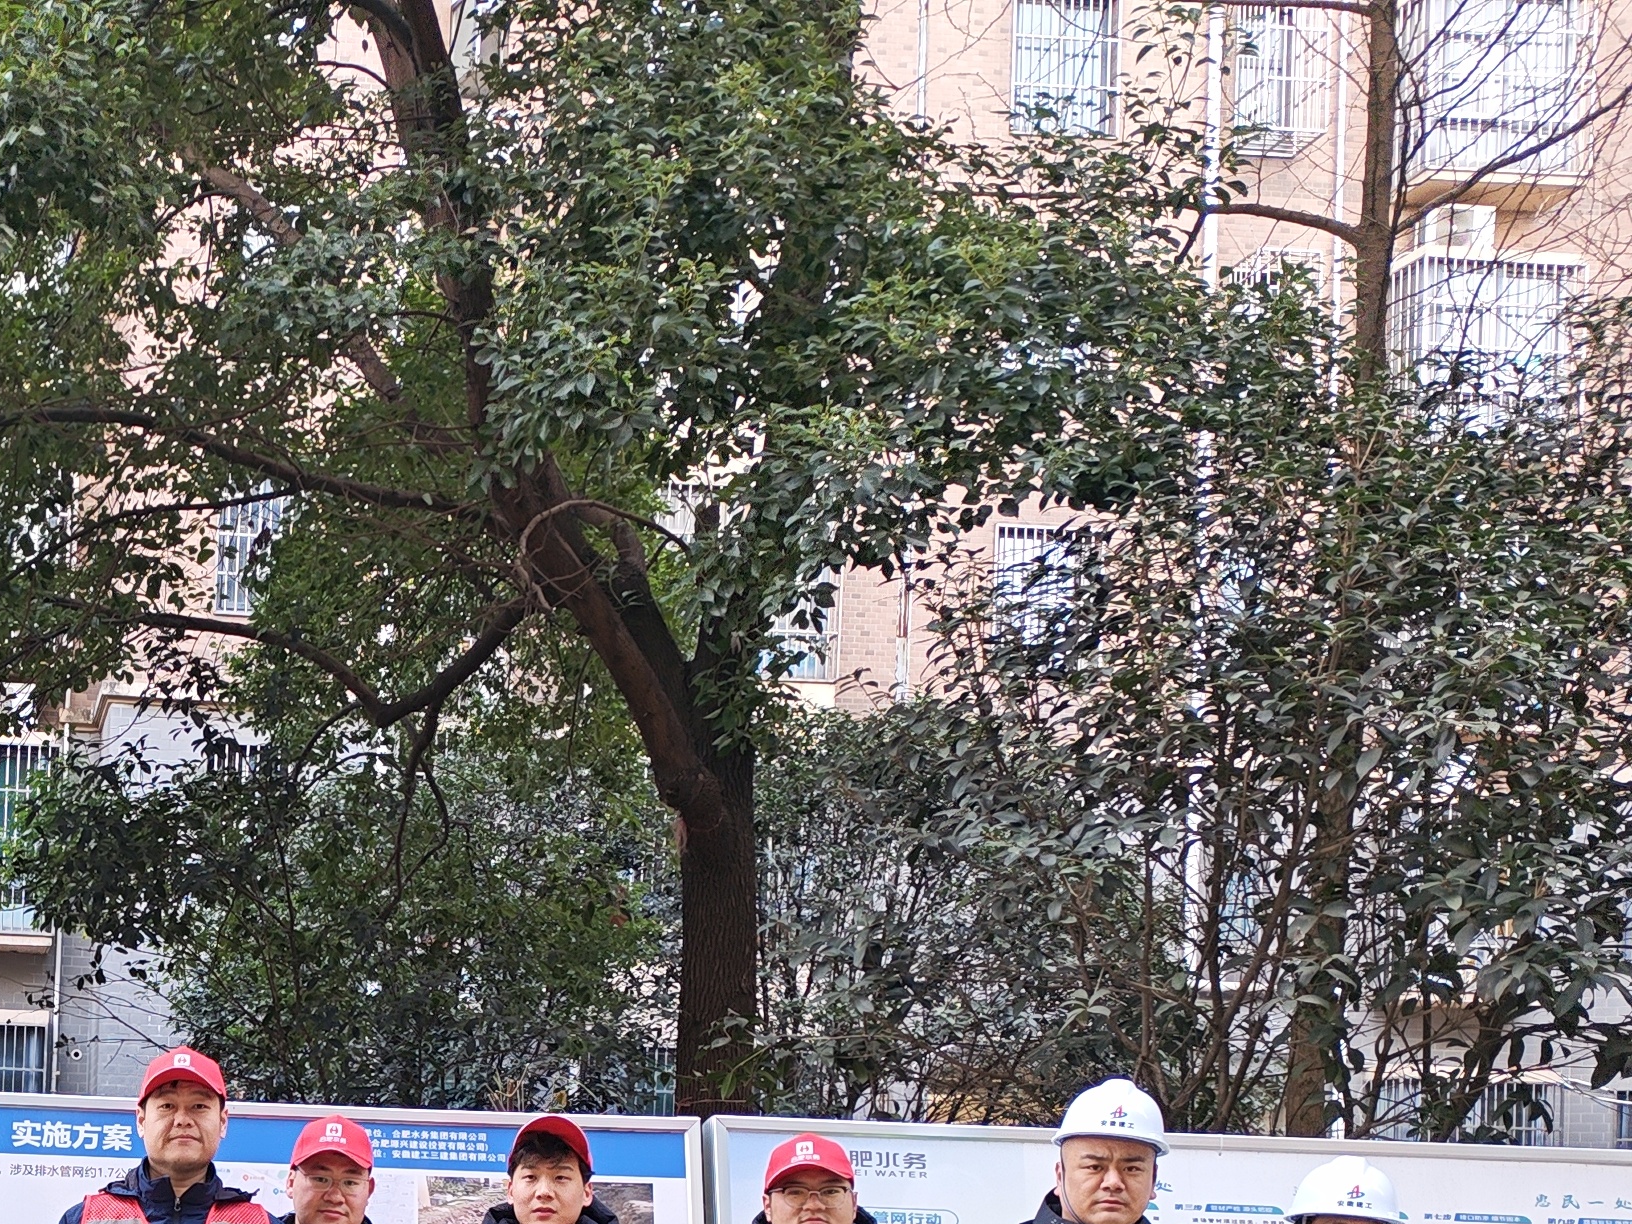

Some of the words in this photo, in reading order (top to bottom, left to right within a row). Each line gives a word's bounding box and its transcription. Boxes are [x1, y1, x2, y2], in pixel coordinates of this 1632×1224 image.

[11, 1119, 133, 1152] 实施方案
[874, 1169, 928, 1179] WATER
